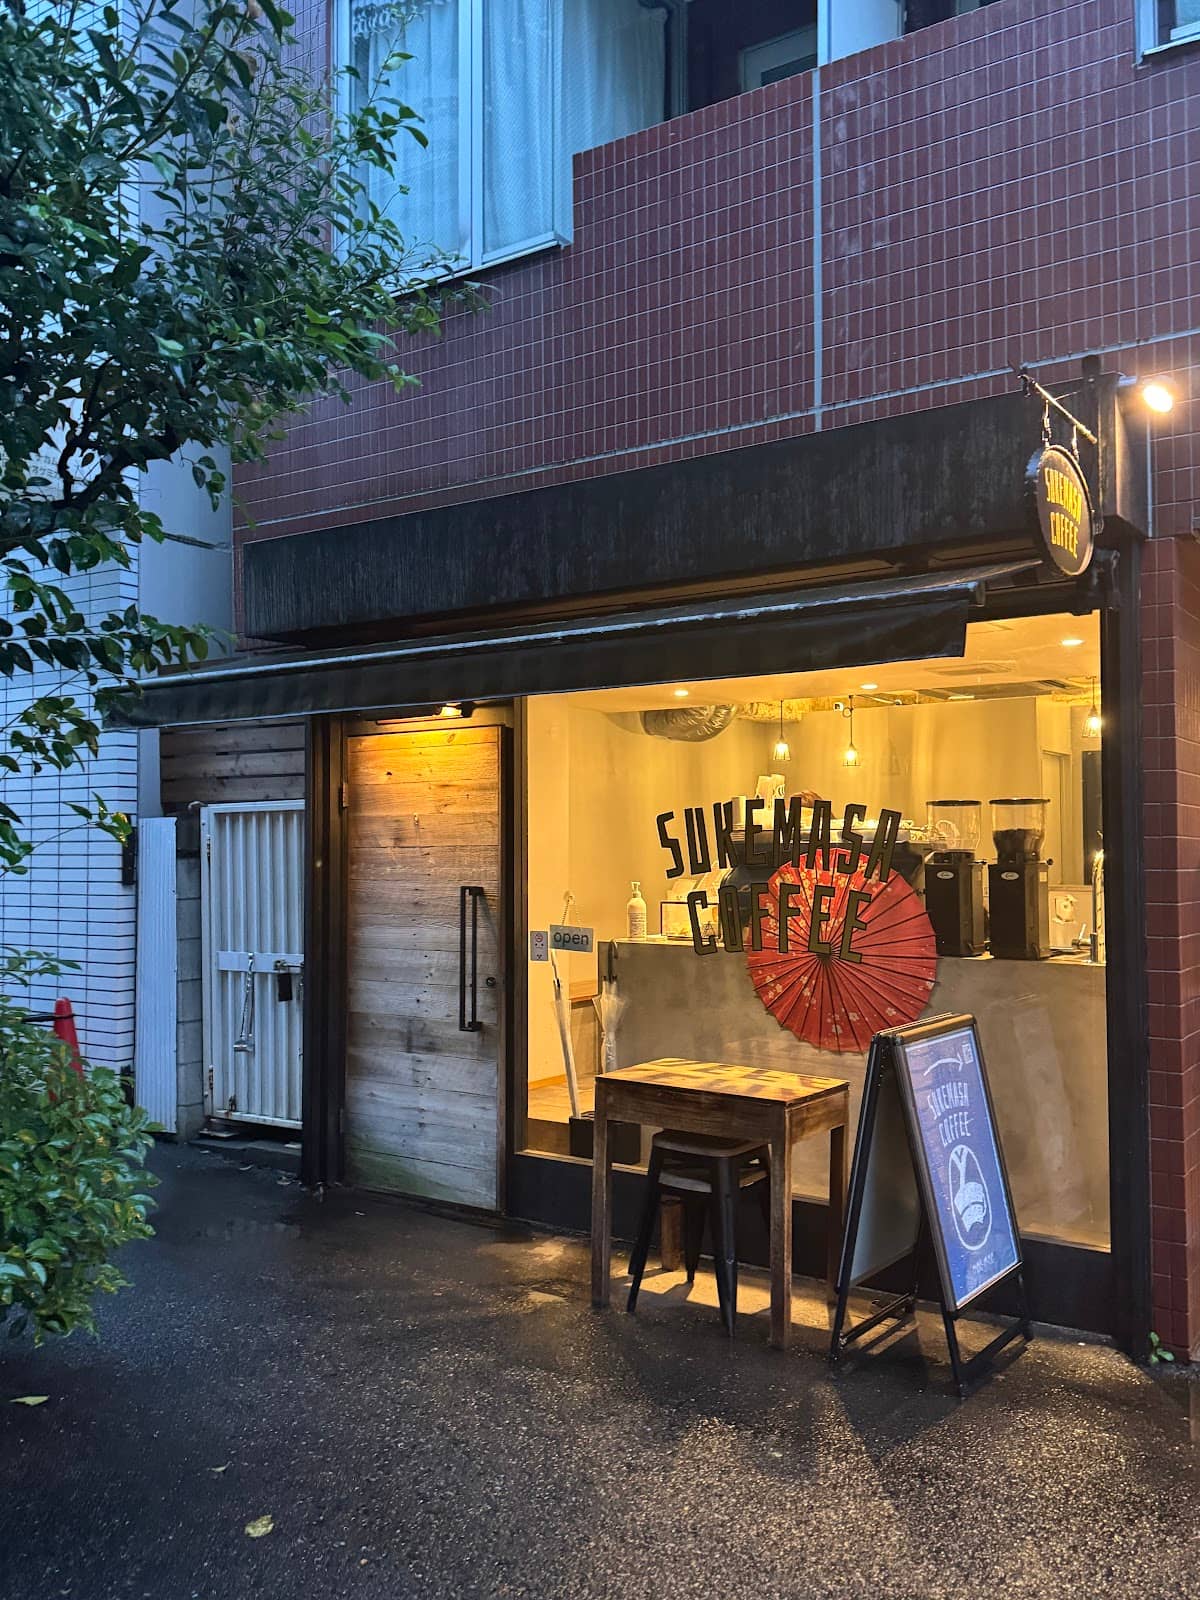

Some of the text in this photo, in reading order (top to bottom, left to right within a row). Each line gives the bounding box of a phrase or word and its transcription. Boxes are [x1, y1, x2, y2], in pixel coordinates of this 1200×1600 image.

[1045, 468, 1081, 525] SUKEMASA
[1050, 512, 1079, 560] COFFEE
[656, 797, 902, 882] SUKEMASA
[553, 932, 589, 947] open
[687, 882, 872, 964] COFFEE
[939, 1112, 973, 1148] COFFEE
